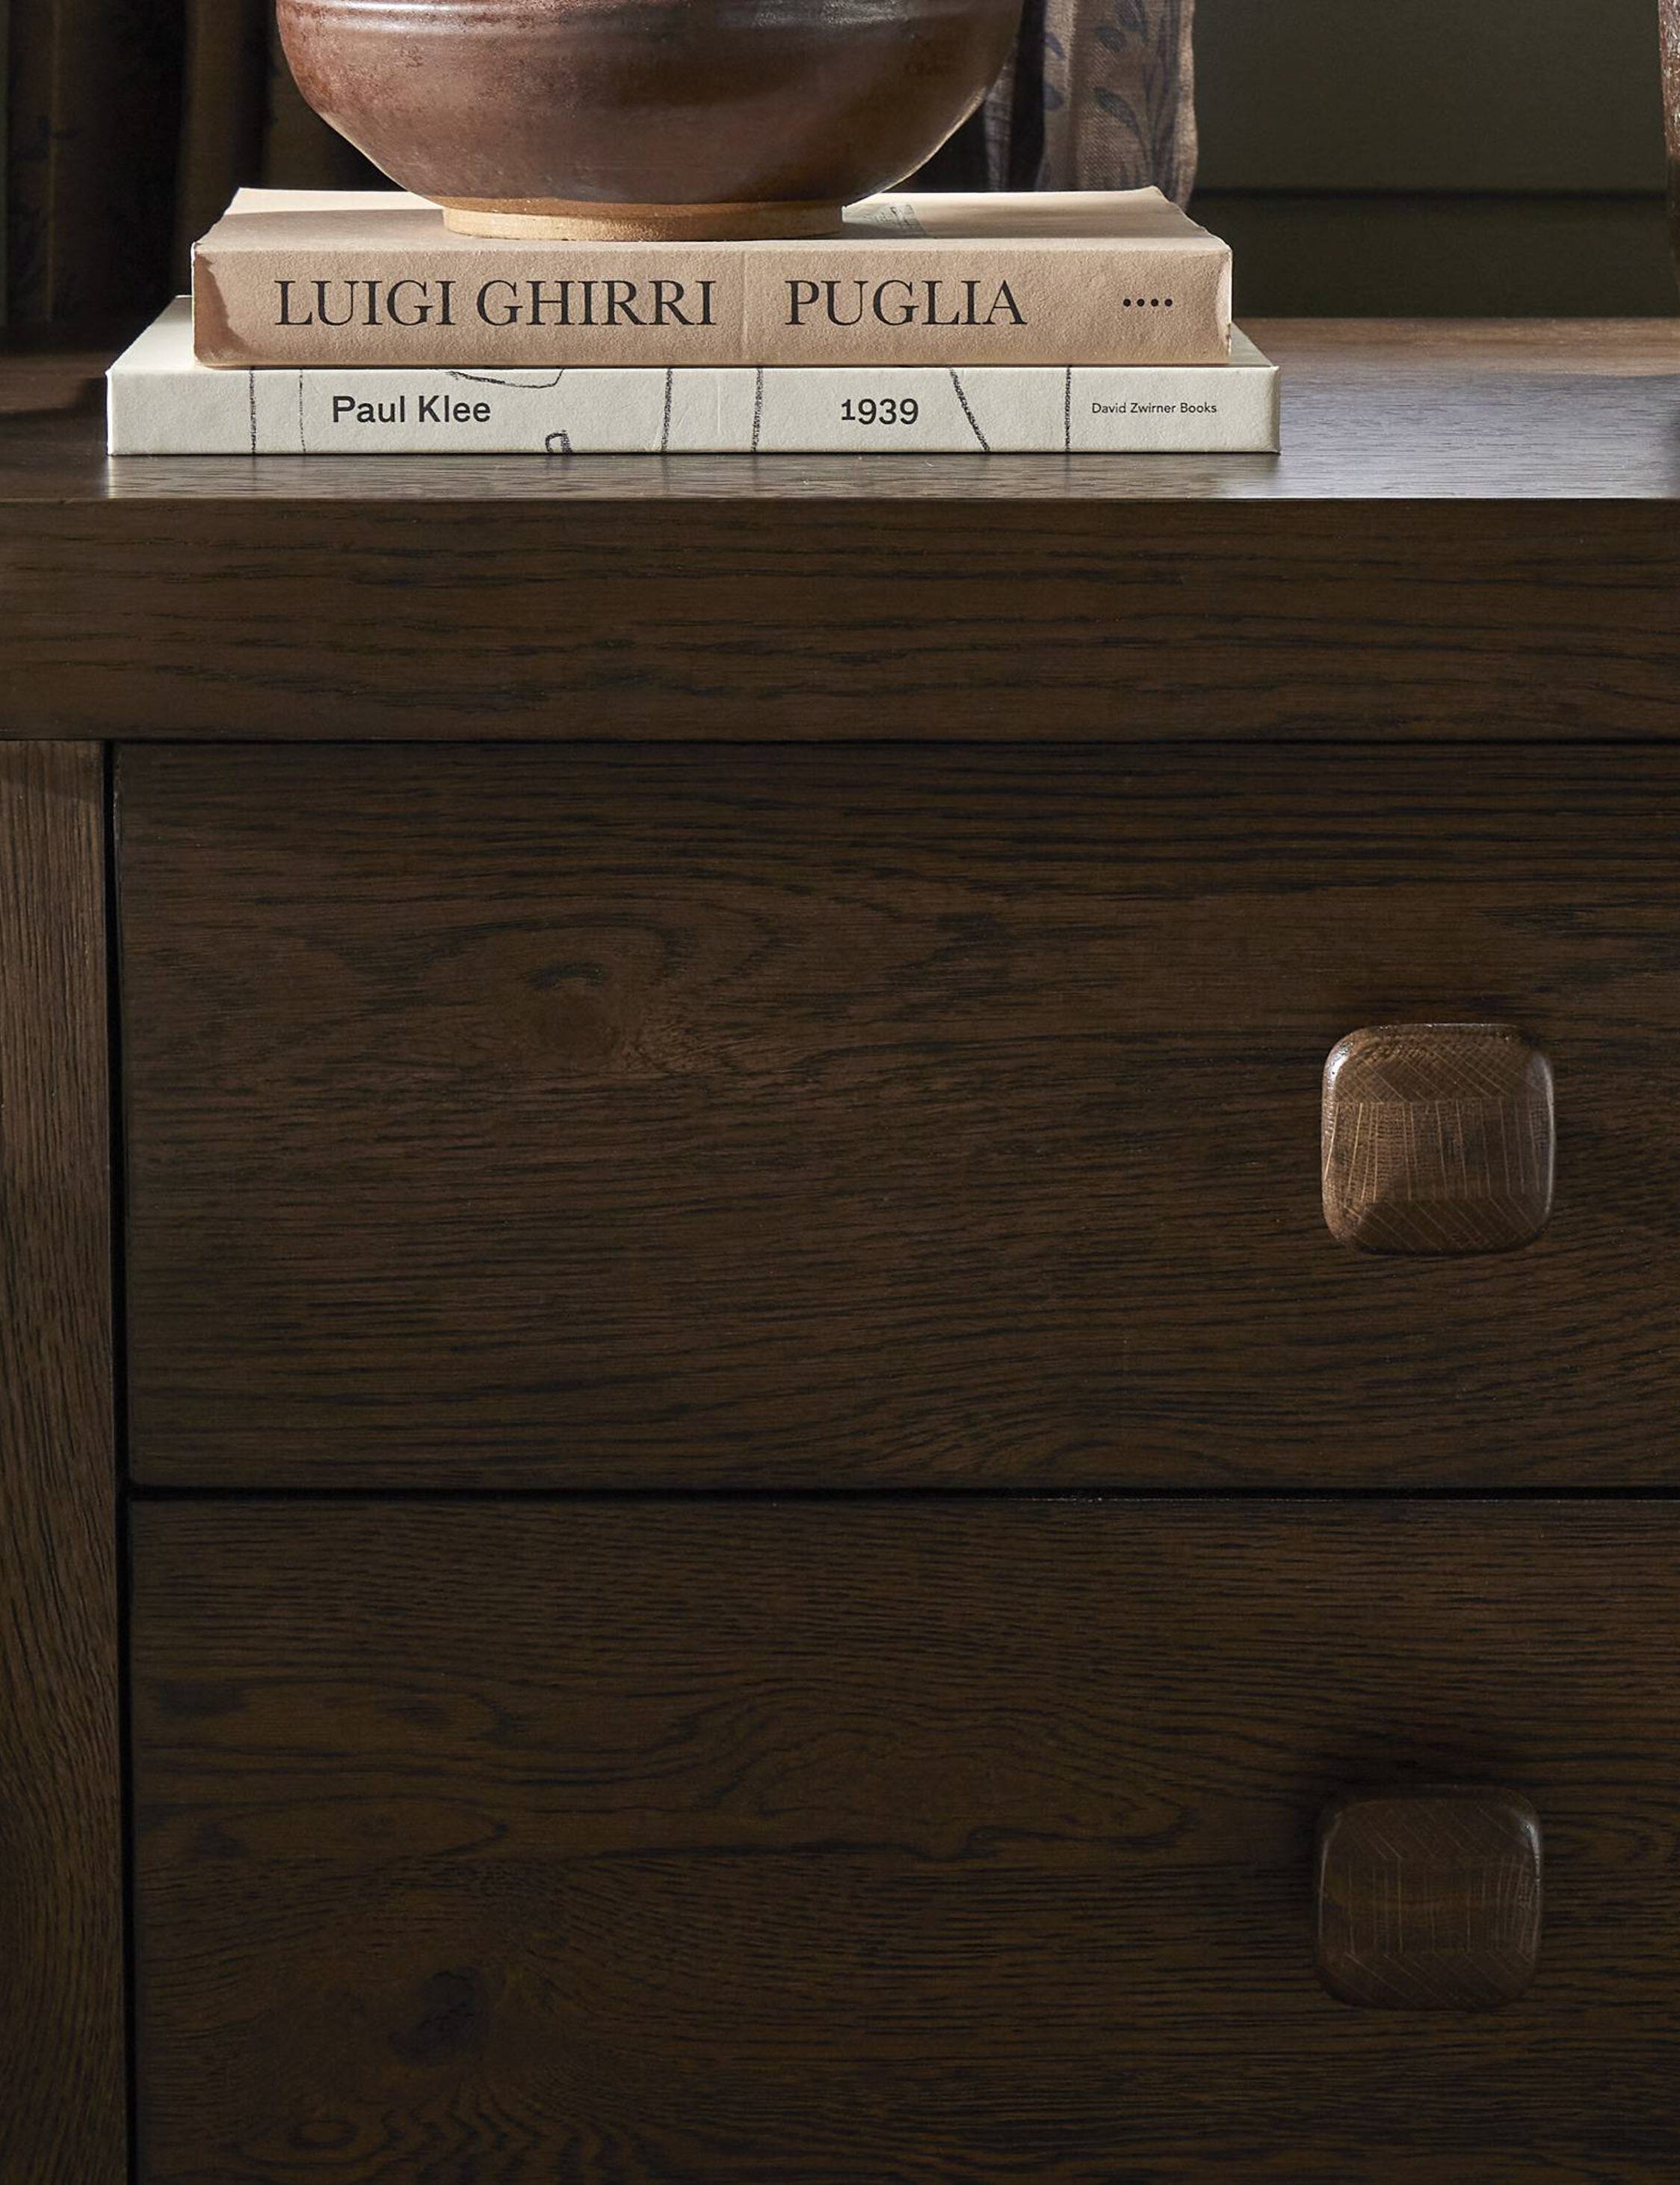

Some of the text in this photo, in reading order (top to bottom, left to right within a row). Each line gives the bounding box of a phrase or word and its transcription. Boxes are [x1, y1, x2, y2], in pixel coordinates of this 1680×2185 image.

[274, 280, 717, 327] LUIGI GHIRRI
[785, 280, 1028, 326] PUGLIA
[333, 395, 491, 423] Paul Klee
[841, 398, 918, 425] 1939
[1092, 401, 1217, 413] David Zwirner Books
